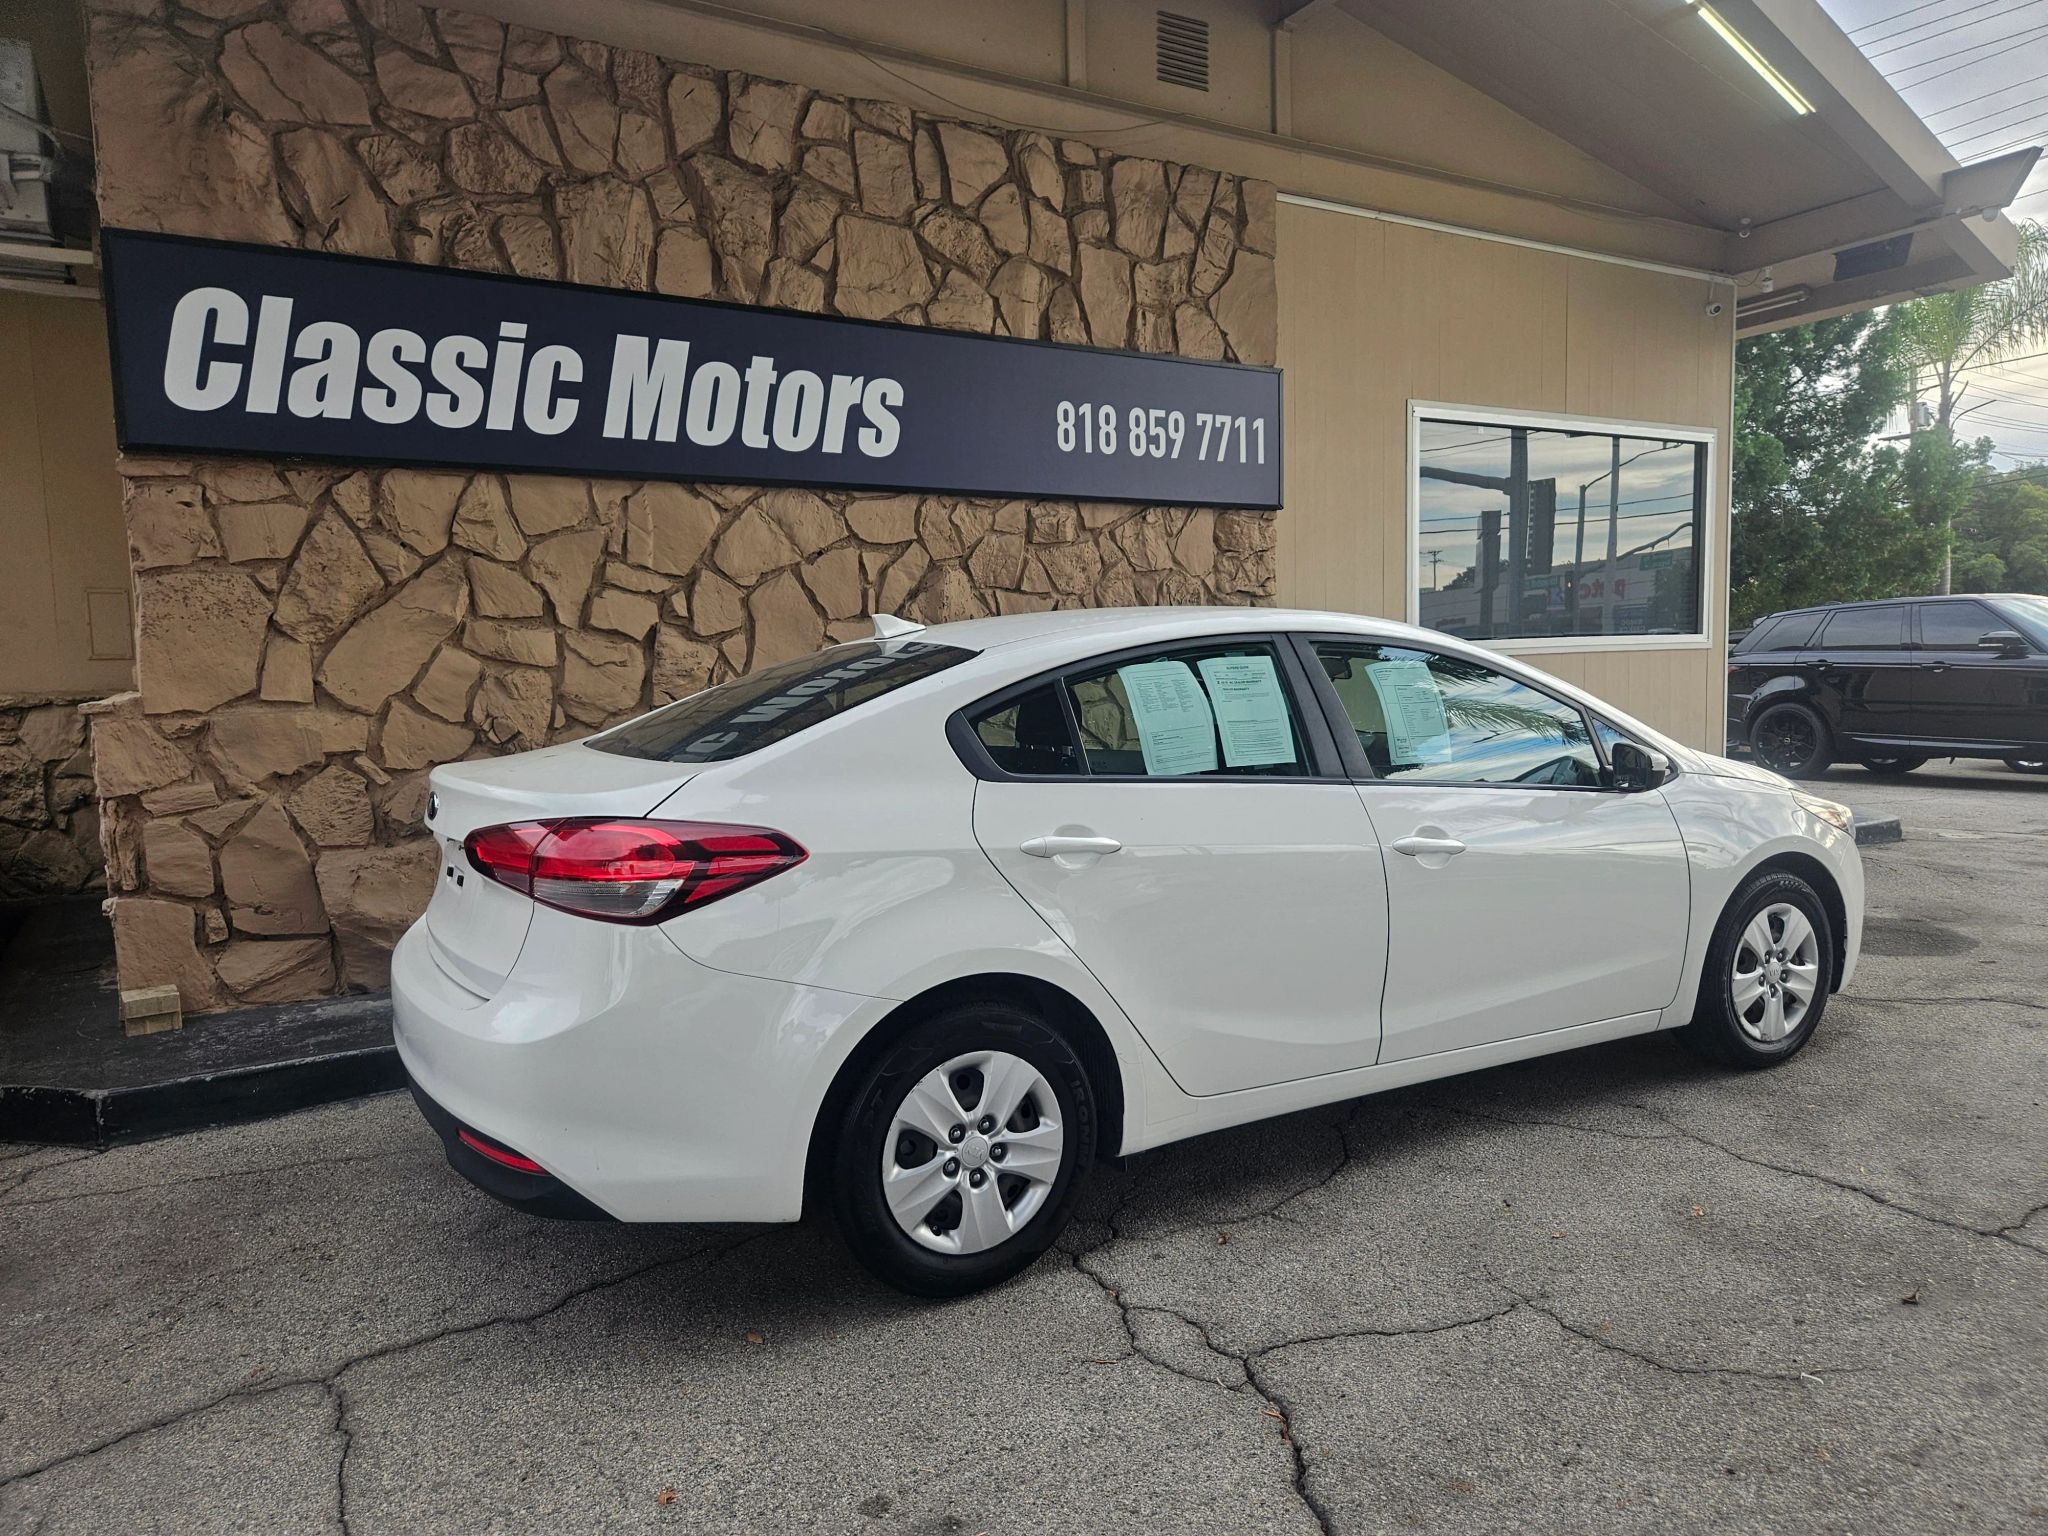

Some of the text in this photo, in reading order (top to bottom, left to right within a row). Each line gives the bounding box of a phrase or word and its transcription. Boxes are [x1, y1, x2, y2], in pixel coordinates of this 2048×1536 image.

[164, 287, 904, 458] Classic Motors
[1056, 400, 1265, 465] 818 859 7711
